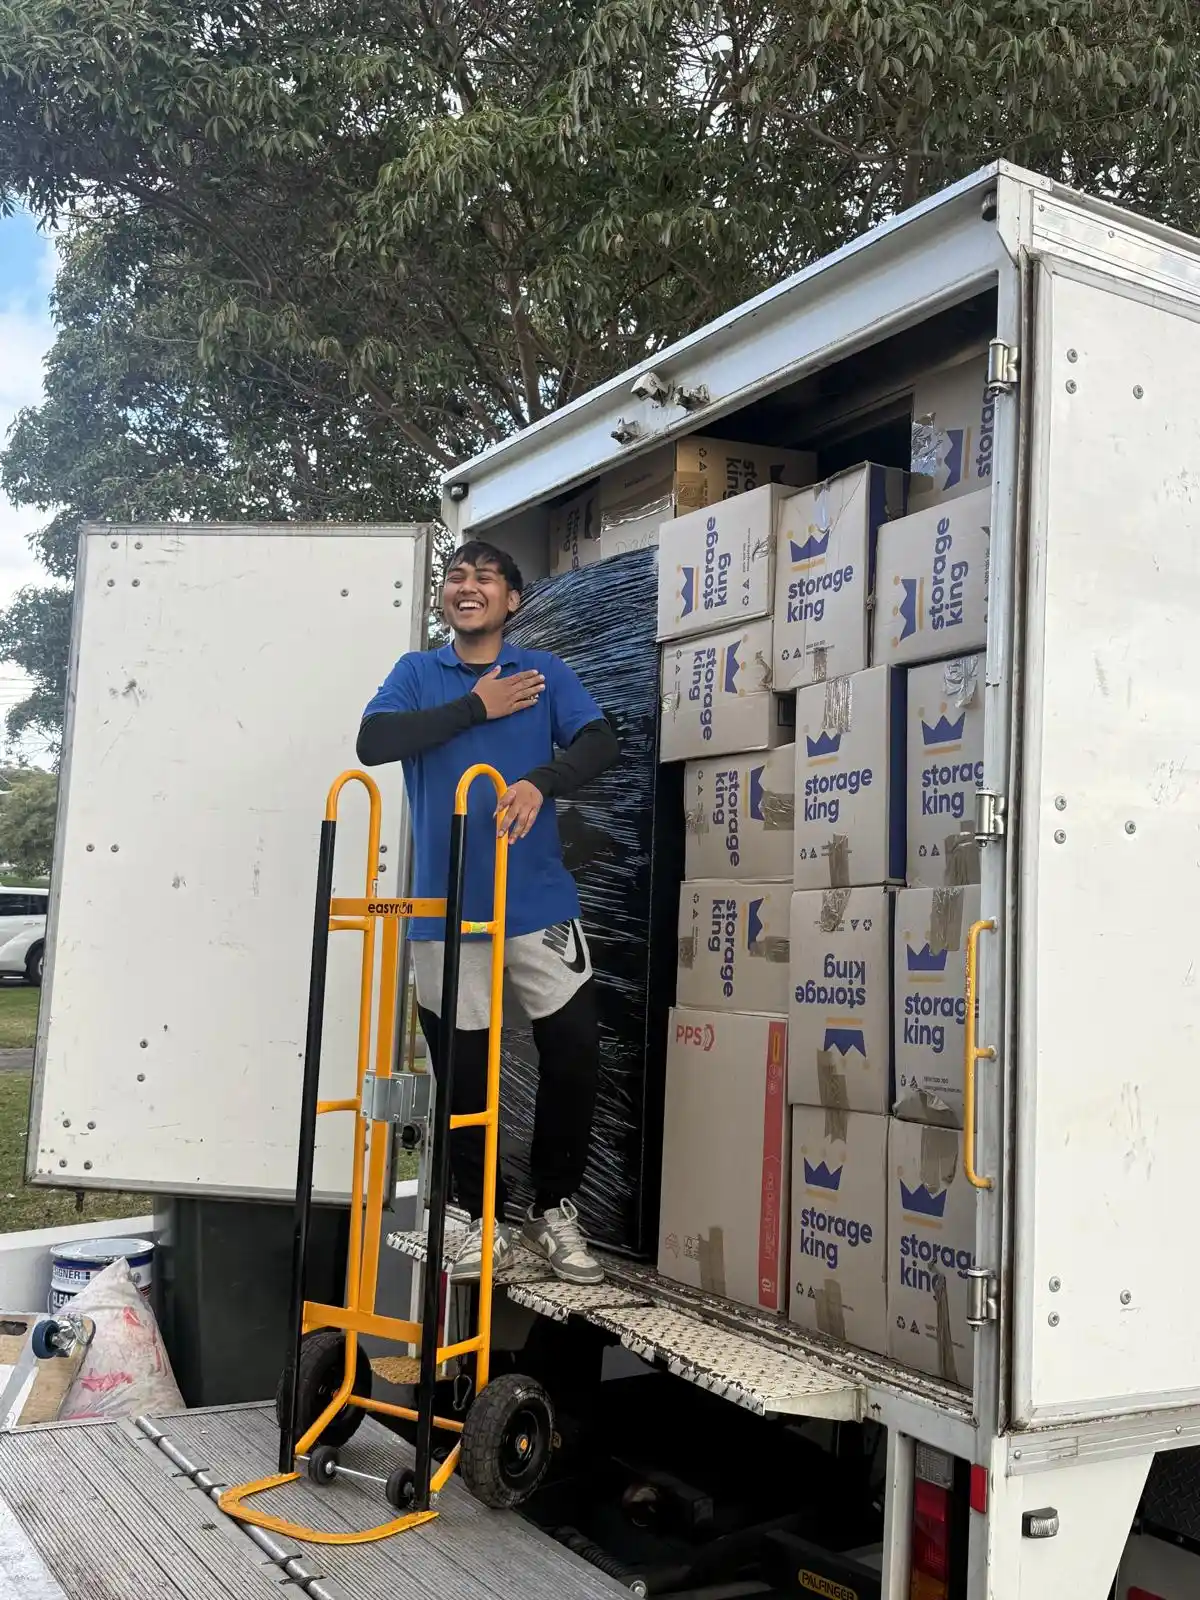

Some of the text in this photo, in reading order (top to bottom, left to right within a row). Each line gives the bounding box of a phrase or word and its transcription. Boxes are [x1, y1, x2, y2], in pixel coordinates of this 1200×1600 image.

[976, 370, 995, 478] storag
[571, 507, 581, 569] storag
[703, 516, 718, 610] storage
[714, 553, 731, 607] king
[788, 565, 854, 600] storage
[929, 517, 952, 630] storage
[787, 599, 825, 623] king
[945, 561, 968, 627] king
[689, 650, 706, 701] king
[700, 648, 716, 740] storage
[805, 768, 872, 796] storage
[921, 760, 984, 788] storag
[712, 771, 728, 825] king
[726, 770, 740, 867] storage
[804, 796, 839, 823] king
[922, 788, 965, 818] king
[708, 899, 725, 952] king
[720, 899, 738, 997] storage
[823, 953, 866, 985] king
[795, 979, 866, 1008] storage
[676, 1024, 702, 1046] PPS
[904, 1018, 945, 1053] king
[801, 1206, 873, 1247] storage
[800, 1229, 838, 1269] king
[900, 1234, 976, 1280] storag
[53, 1291, 72, 1306] CLEA
